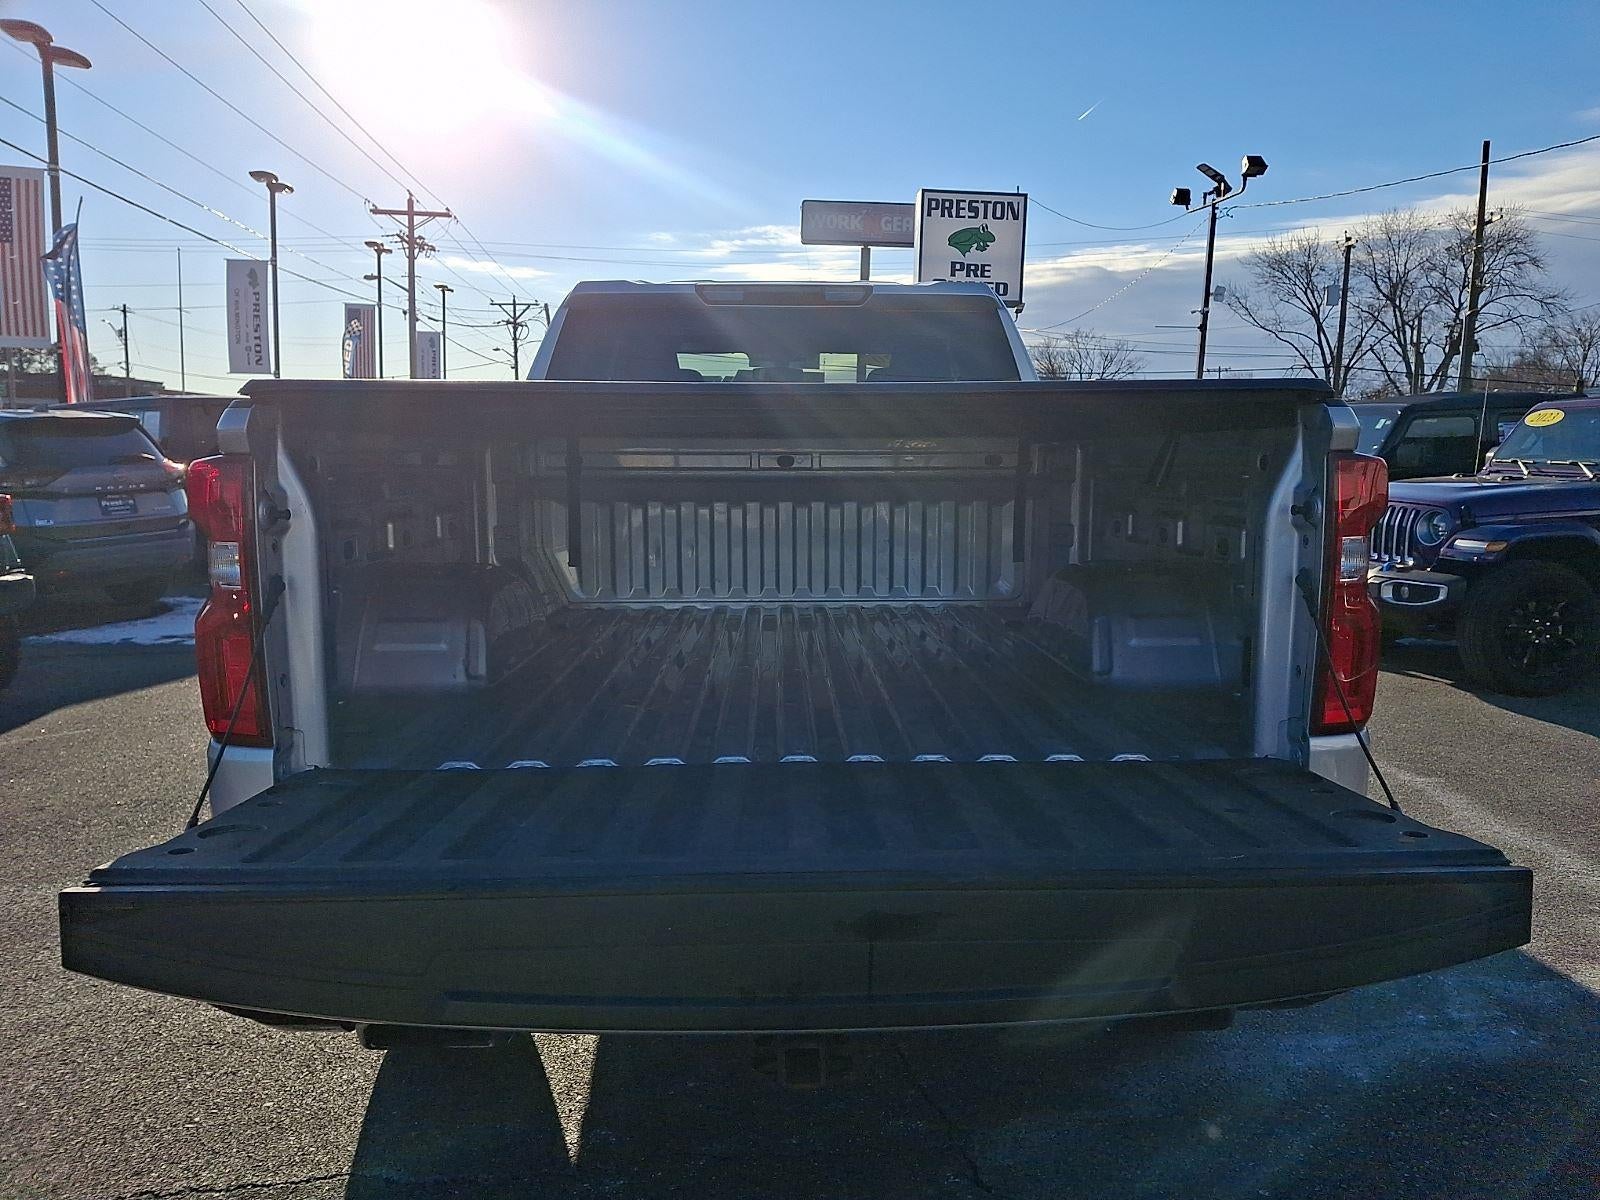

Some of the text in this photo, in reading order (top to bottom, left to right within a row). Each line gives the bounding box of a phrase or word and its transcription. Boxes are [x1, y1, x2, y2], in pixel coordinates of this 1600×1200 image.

[927, 198, 1020, 221] PRESTON
[808, 214, 864, 230] WORK
[880, 215, 913, 232] GEA
[950, 261, 992, 278] PRE
[252, 291, 263, 366] PRESTON
